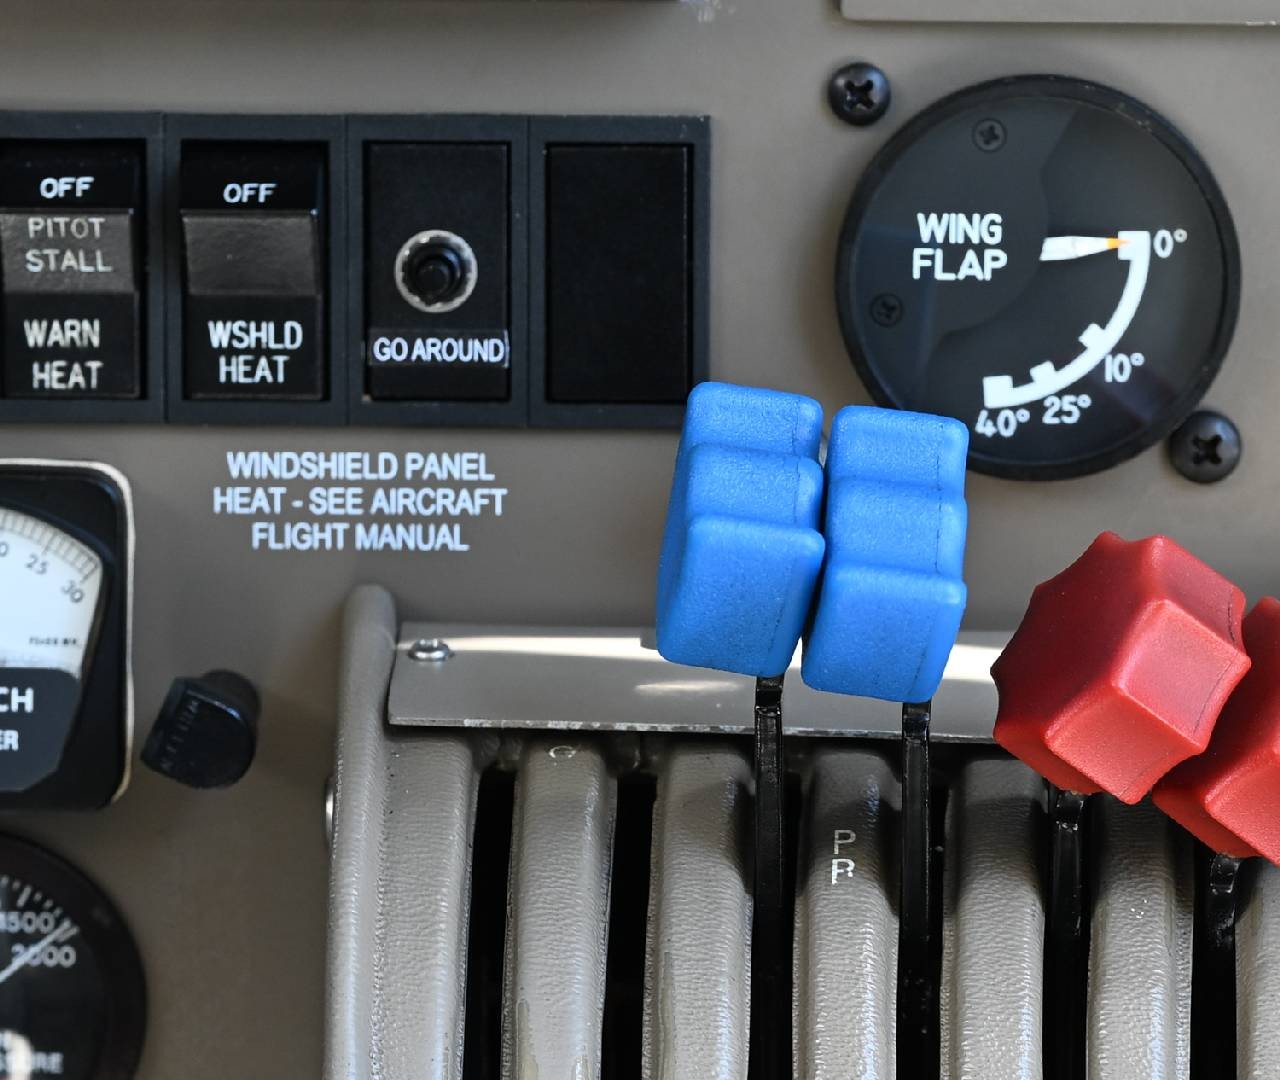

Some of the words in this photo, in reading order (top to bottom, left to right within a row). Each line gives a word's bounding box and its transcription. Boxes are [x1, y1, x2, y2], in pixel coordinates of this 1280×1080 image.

[39, 176, 94, 199] OFF
[224, 183, 276, 203] OFF
[28, 217, 105, 239] PITOT
[917, 213, 1003, 244] WING
[1153, 229, 1187, 258] 0°
[25, 249, 112, 273] STALL
[913, 248, 1007, 280] FLAP
[24, 320, 100, 348] WARN
[208, 321, 303, 349] WSHLD
[373, 338, 407, 362] GO
[412, 338, 505, 362] AROUND
[32, 362, 102, 389] HEAT
[219, 356, 289, 383] HEAT
[1104, 353, 1144, 382] 10°
[975, 408, 1030, 437] 40°
[1042, 394, 1091, 424] 25°
[227, 451, 398, 481] WINDSHIELD
[405, 453, 495, 482] PANEL
[214, 488, 286, 514] HEAT
[309, 488, 363, 515] SEE
[370, 489, 507, 516] AIRCRAFT
[252, 523, 348, 550] FLIGHT
[354, 524, 469, 552] MANUAL
[25, 554, 48, 574] 25
[61, 580, 84, 603] 30
[12, 945, 76, 967] 2000
